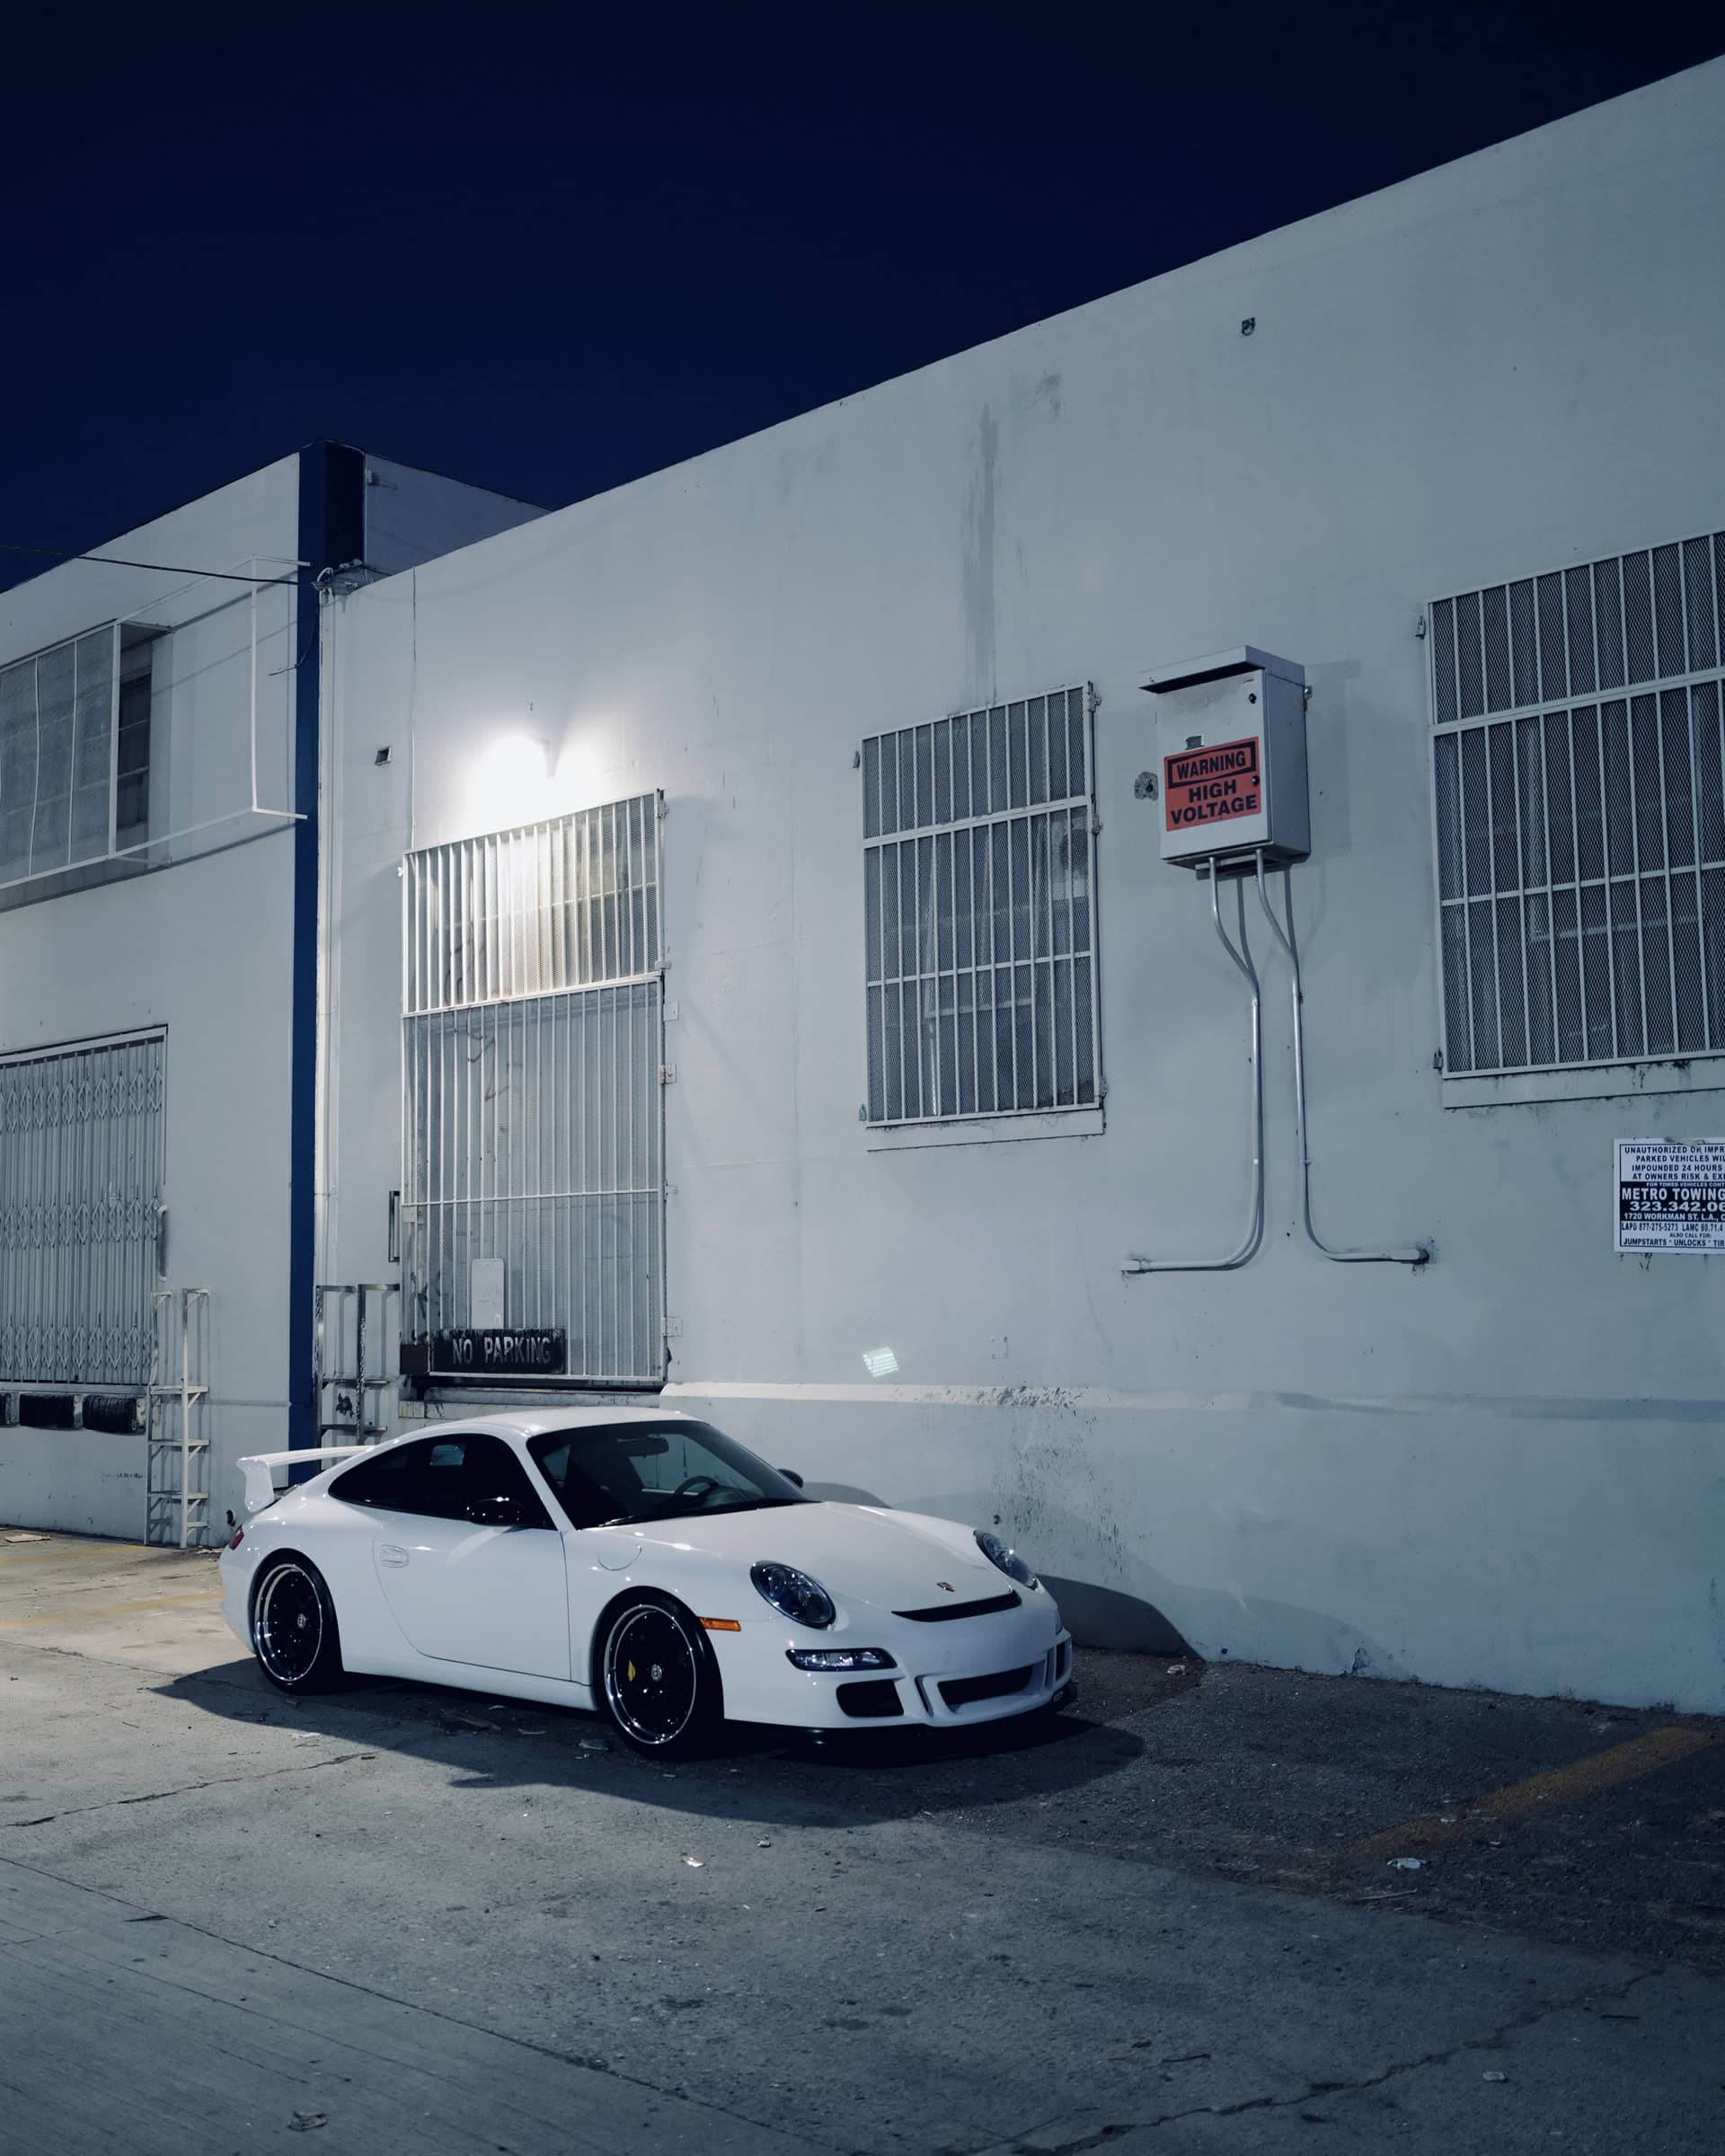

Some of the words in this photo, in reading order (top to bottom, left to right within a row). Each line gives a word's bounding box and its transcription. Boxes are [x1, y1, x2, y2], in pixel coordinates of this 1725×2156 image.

[1176, 751, 1246, 780] WARNING
[1189, 779, 1237, 802] HIGH
[1171, 794, 1257, 825] VOLTAGE
[1681, 1172, 1700, 1180] RISK
[1622, 1188, 1668, 1200] METRO
[1672, 1188, 1725, 1201] TOWING
[1644, 1213, 1685, 1221] WORKMAN
[1622, 1223, 1638, 1231] LAPD
[1682, 1223, 1699, 1232] LAMC
[1674, 1239, 1706, 1247] UNLOCKS
[452, 1338, 473, 1364] NO
[483, 1336, 551, 1364] PARKING
